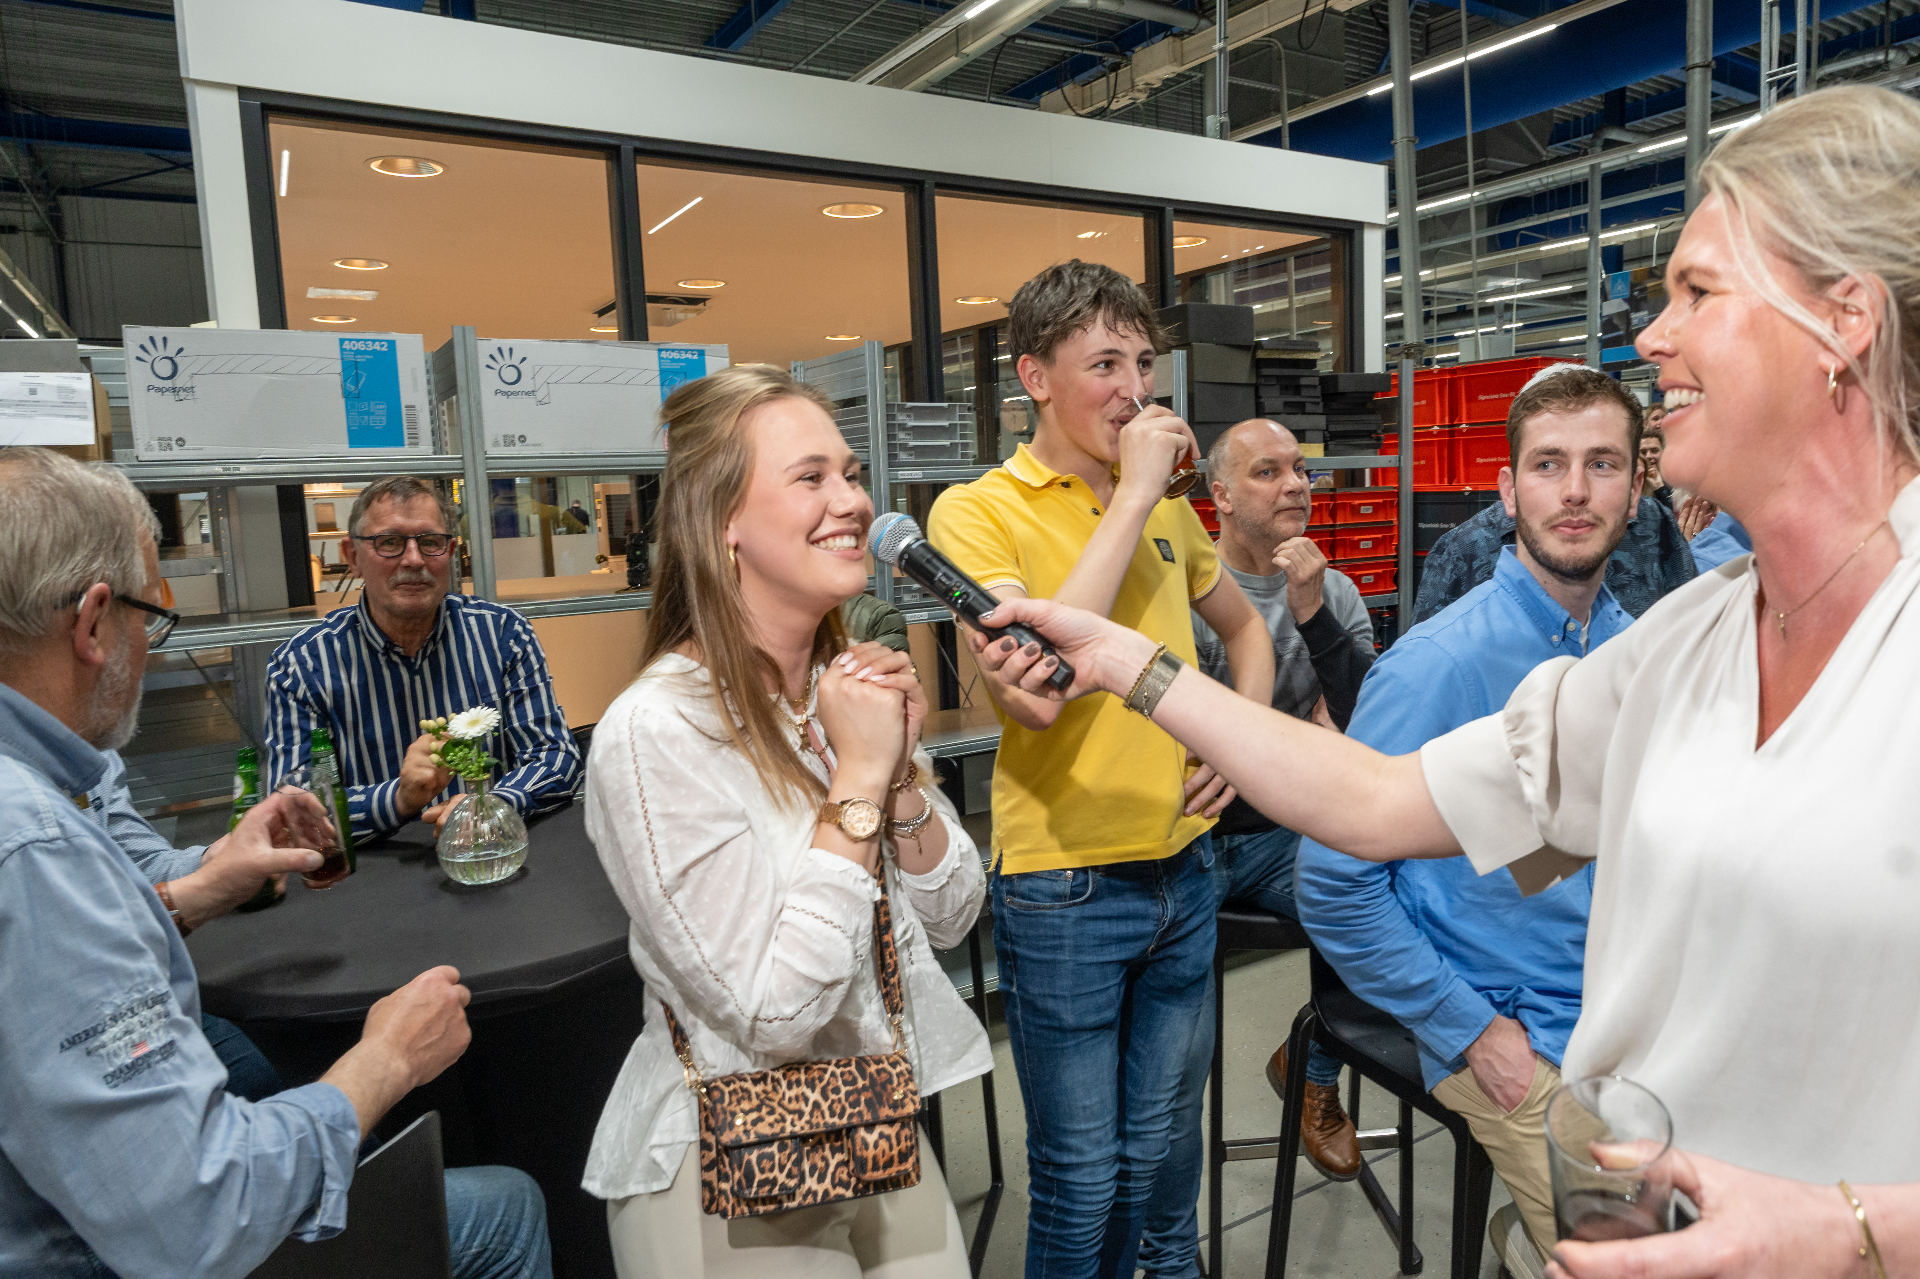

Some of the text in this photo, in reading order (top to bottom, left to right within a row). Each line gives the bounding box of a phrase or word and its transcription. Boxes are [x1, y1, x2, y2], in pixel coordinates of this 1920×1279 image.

[342, 340, 389, 351] 406342
[660, 350, 699, 360] 406342
[147, 384, 196, 396] Papernet
[494, 388, 537, 399] Papernet
